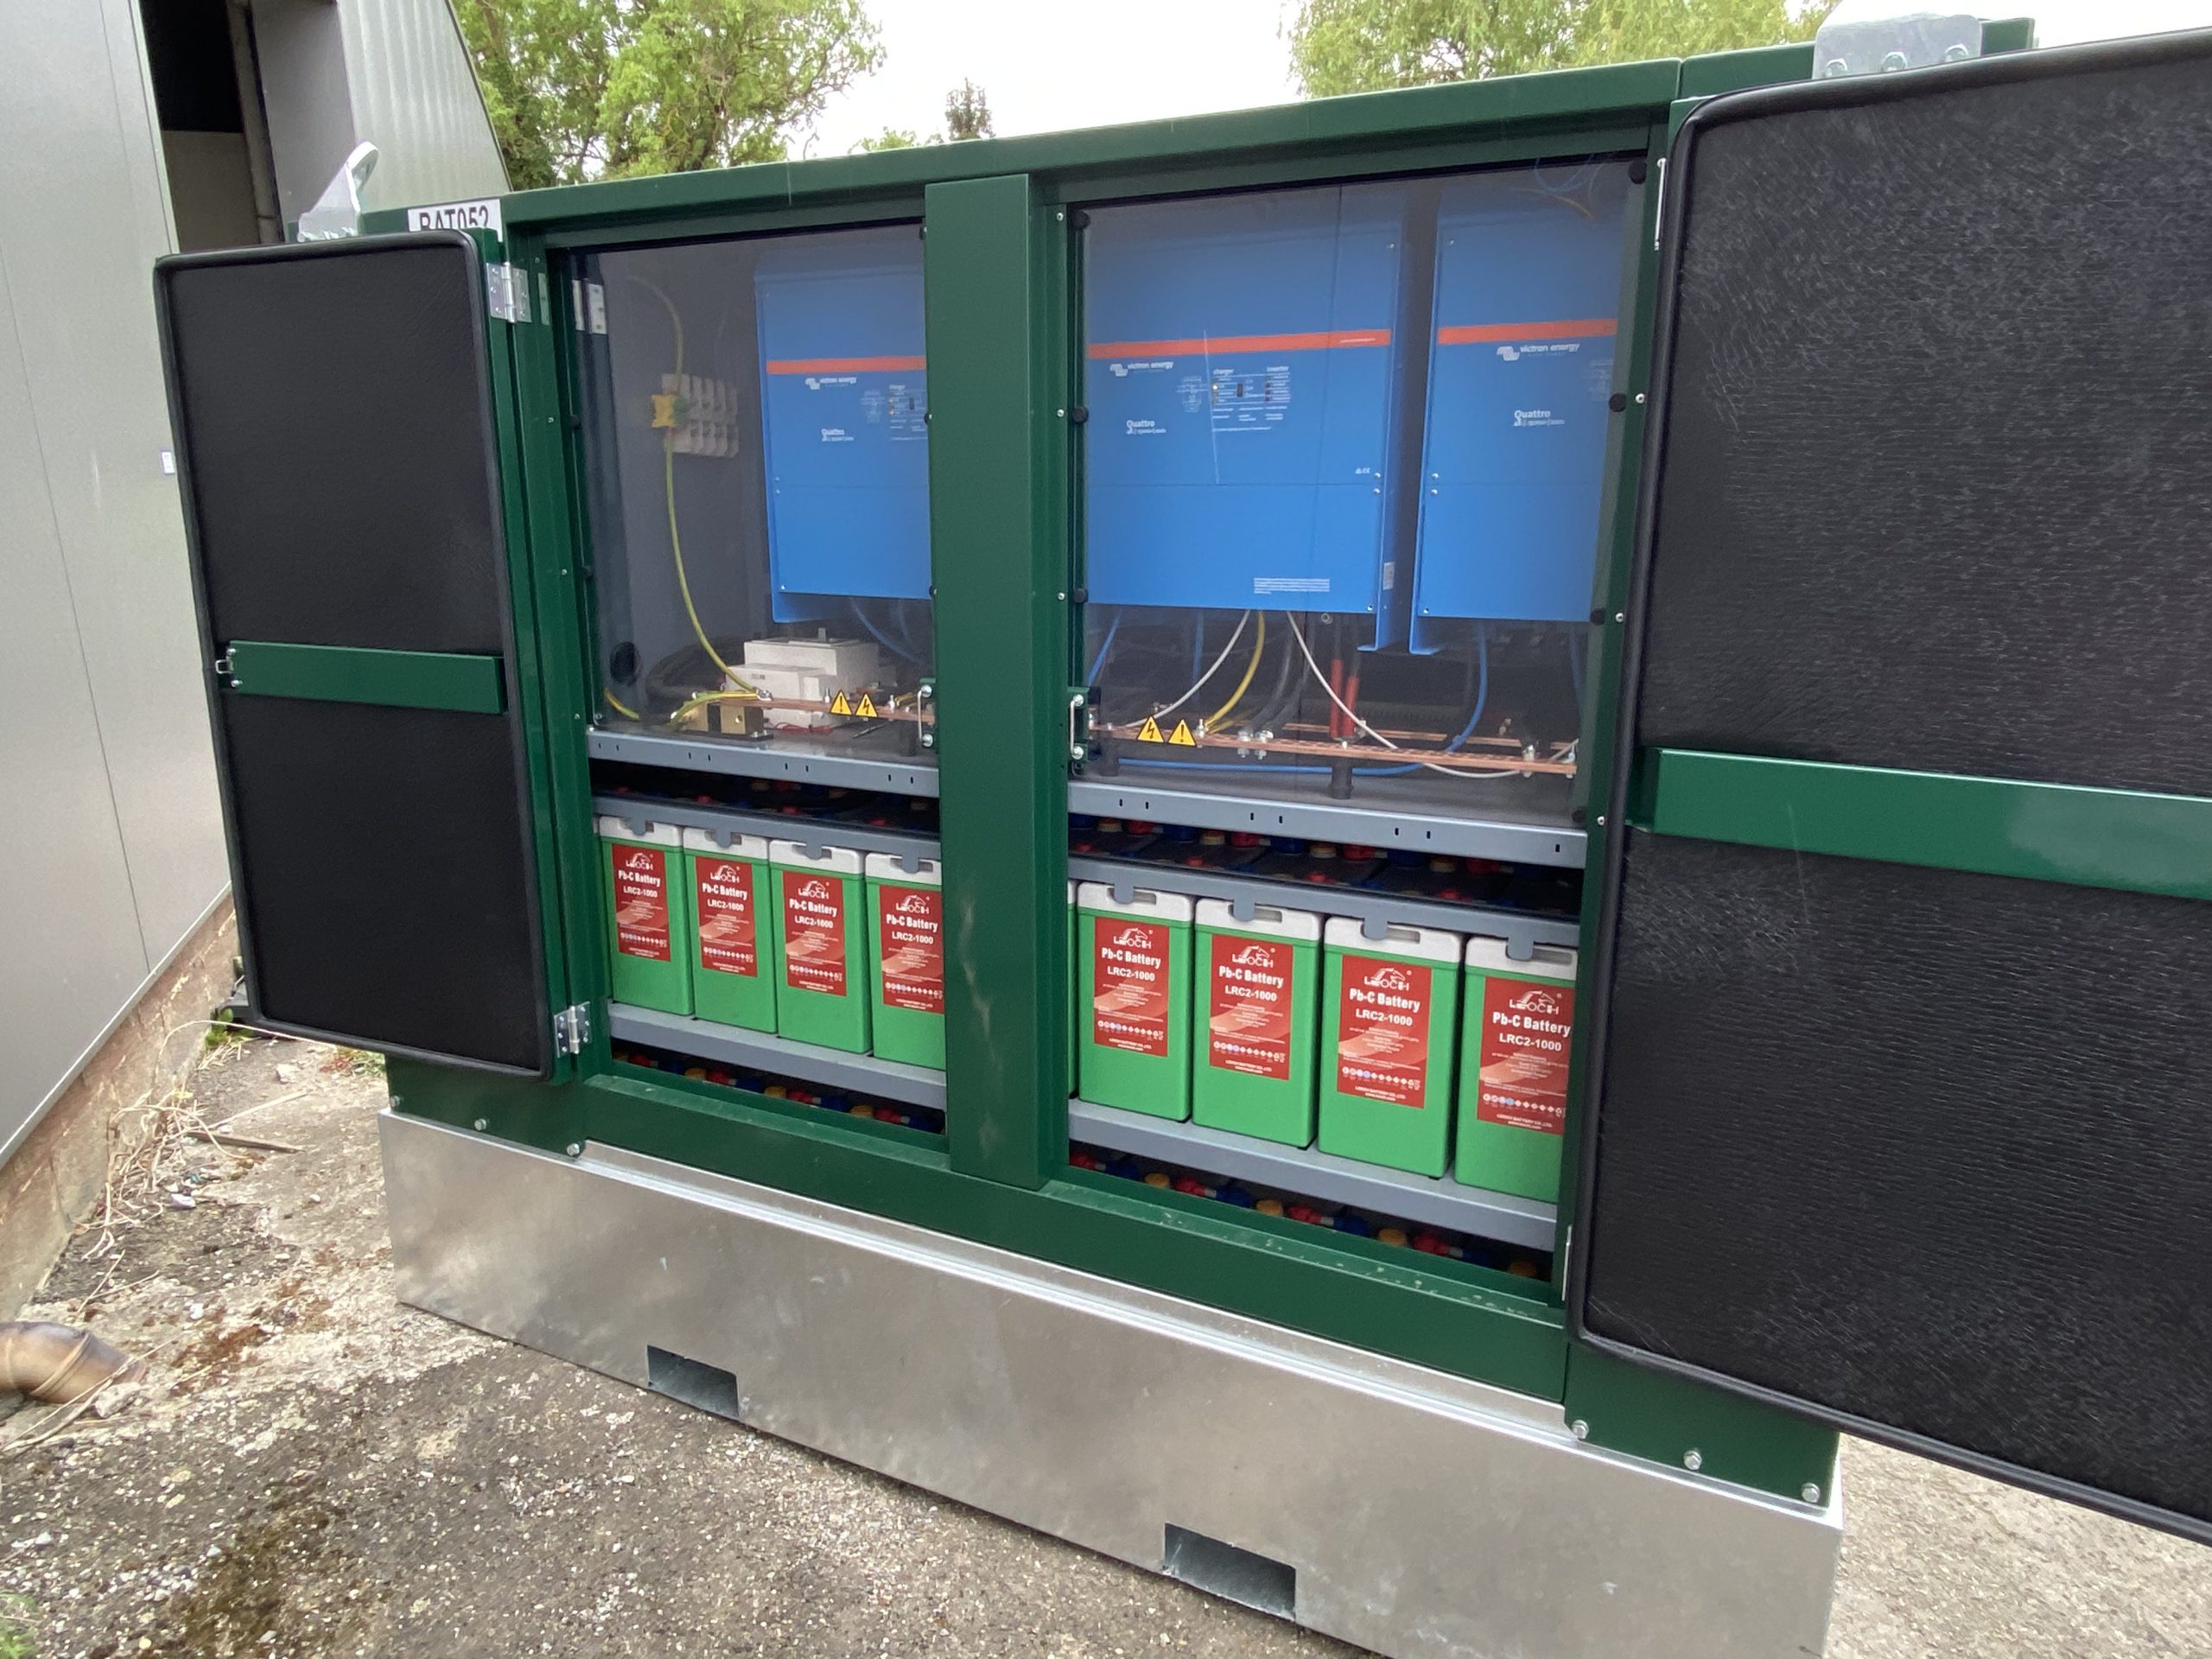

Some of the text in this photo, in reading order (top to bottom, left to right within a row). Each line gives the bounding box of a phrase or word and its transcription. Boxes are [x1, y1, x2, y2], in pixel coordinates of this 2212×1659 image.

[1550, 344, 1580, 353] energy
[1514, 410, 1551, 419] Quattro
[1127, 420, 1155, 429] Quattro
[634, 873, 661, 887] Battery
[702, 882, 747, 900] Pb-C Battery
[707, 899, 745, 912] LRC2-1000
[789, 898, 837, 918] Pb-C Battery
[794, 915, 834, 929] LRC2-1000
[886, 913, 938, 933] Pb-C Battery
[892, 931, 933, 944] LRC2-1000
[1101, 947, 1161, 969] Pb-C Battery
[1107, 965, 1155, 982] LRC2-1000
[1218, 965, 1284, 988] Pb-C Battery
[1224, 984, 1278, 1002] LRC2-1000
[1349, 988, 1421, 1014] Pb-C Battery
[1355, 1007, 1414, 1027] LRC2-1000
[1492, 1011, 1572, 1038] Pb-C Battery
[1498, 1033, 1562, 1052] LRC2-1000
